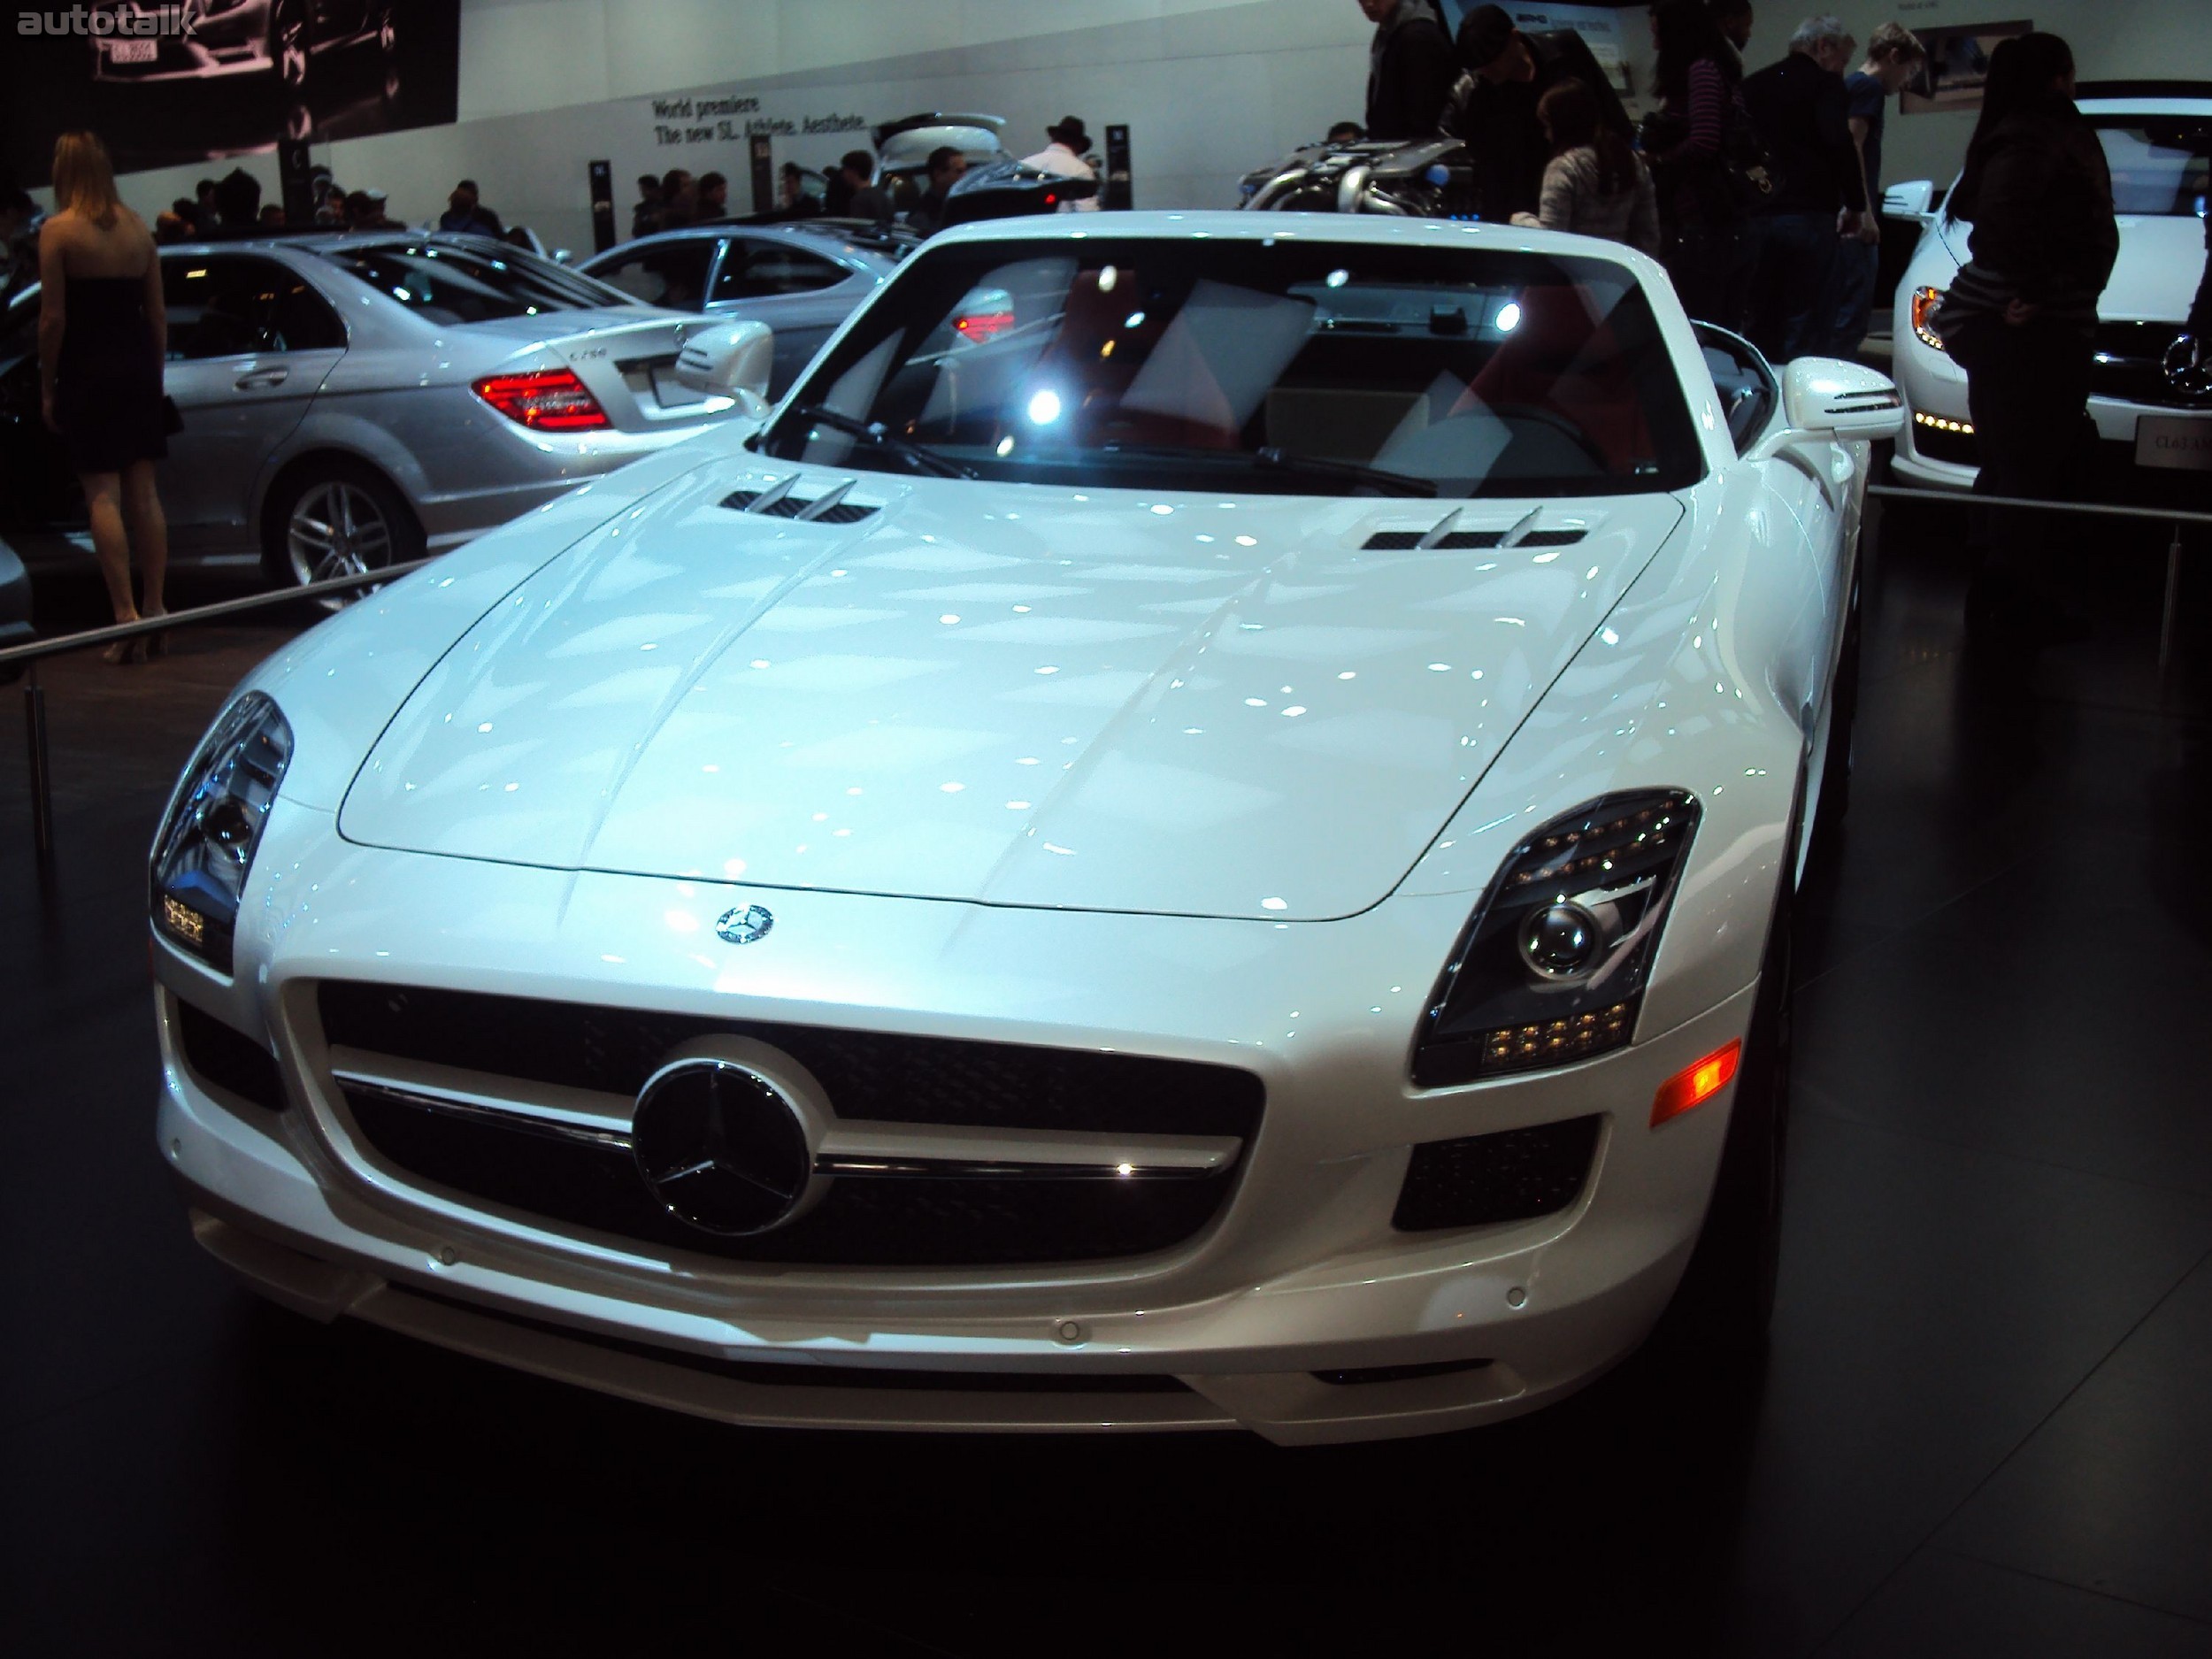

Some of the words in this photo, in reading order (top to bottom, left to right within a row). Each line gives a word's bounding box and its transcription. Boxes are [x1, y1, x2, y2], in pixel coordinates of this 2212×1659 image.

[653, 97, 693, 119] World
[696, 96, 759, 121] premiere
[655, 126, 682, 144] The
[686, 127, 713, 142] new
